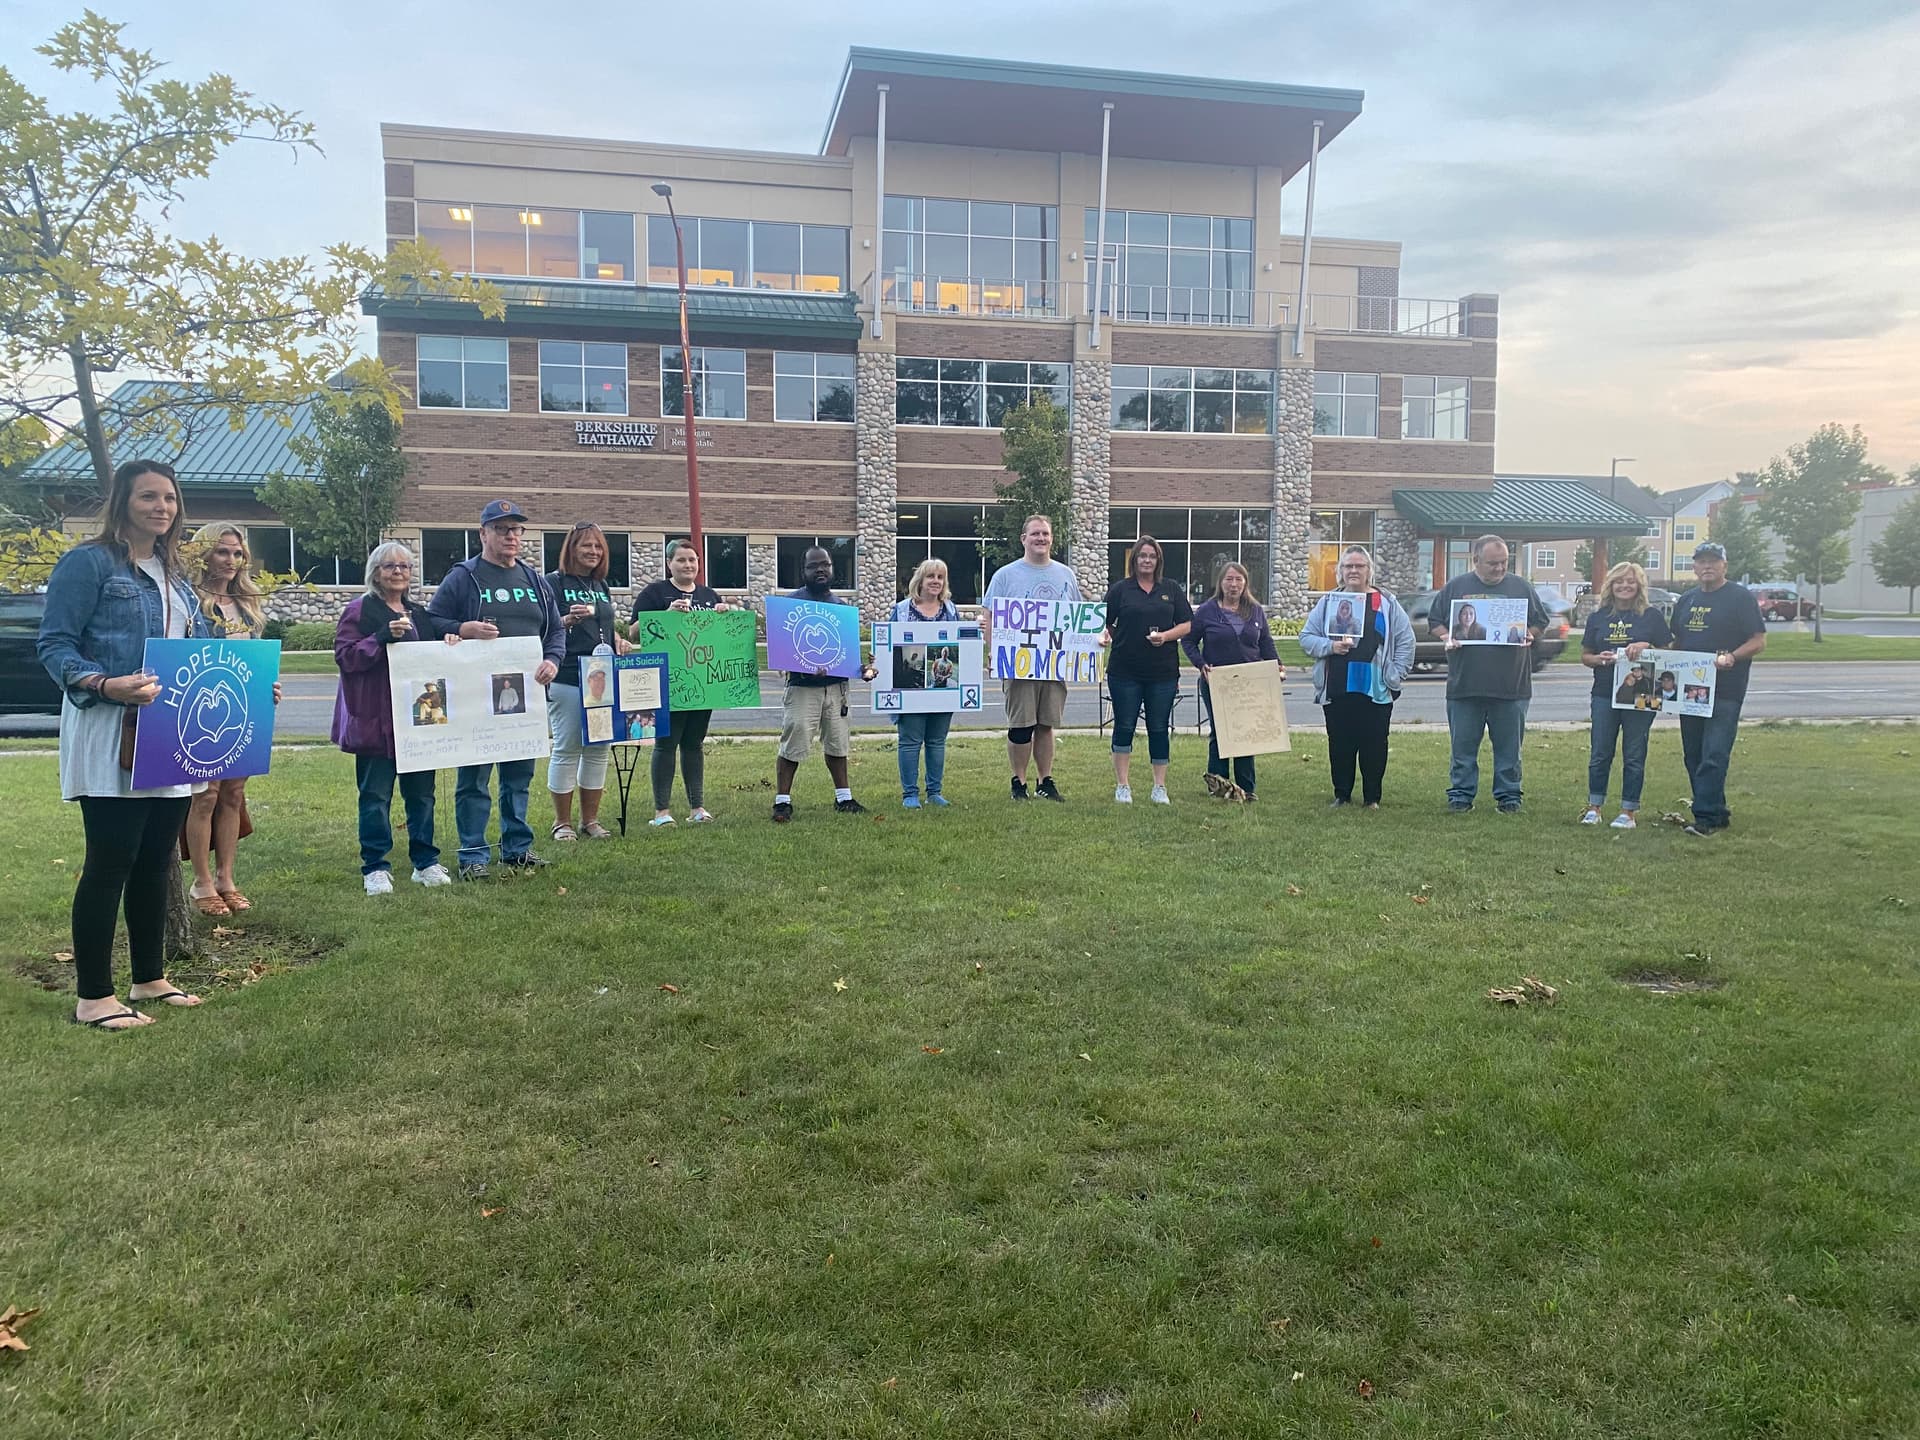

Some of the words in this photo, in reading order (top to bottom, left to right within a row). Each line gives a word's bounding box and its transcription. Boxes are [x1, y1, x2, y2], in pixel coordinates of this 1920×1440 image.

[574, 420, 658, 434] BERKSHIRE
[577, 433, 656, 446] HATHAWAY
[674, 427, 711, 439] Miigan
[783, 603, 812, 633] HOPE
[815, 604, 841, 627] Lives
[993, 598, 1049, 632] HOPE
[163, 644, 214, 708] HOPE
[218, 643, 253, 683] Lives
[614, 655, 634, 668] Fight
[635, 655, 665, 666] Suicide
[706, 657, 758, 685] MATTER
[172, 749, 182, 763] in
[181, 761, 223, 778] Northern
[223, 720, 255, 769] Michigan
